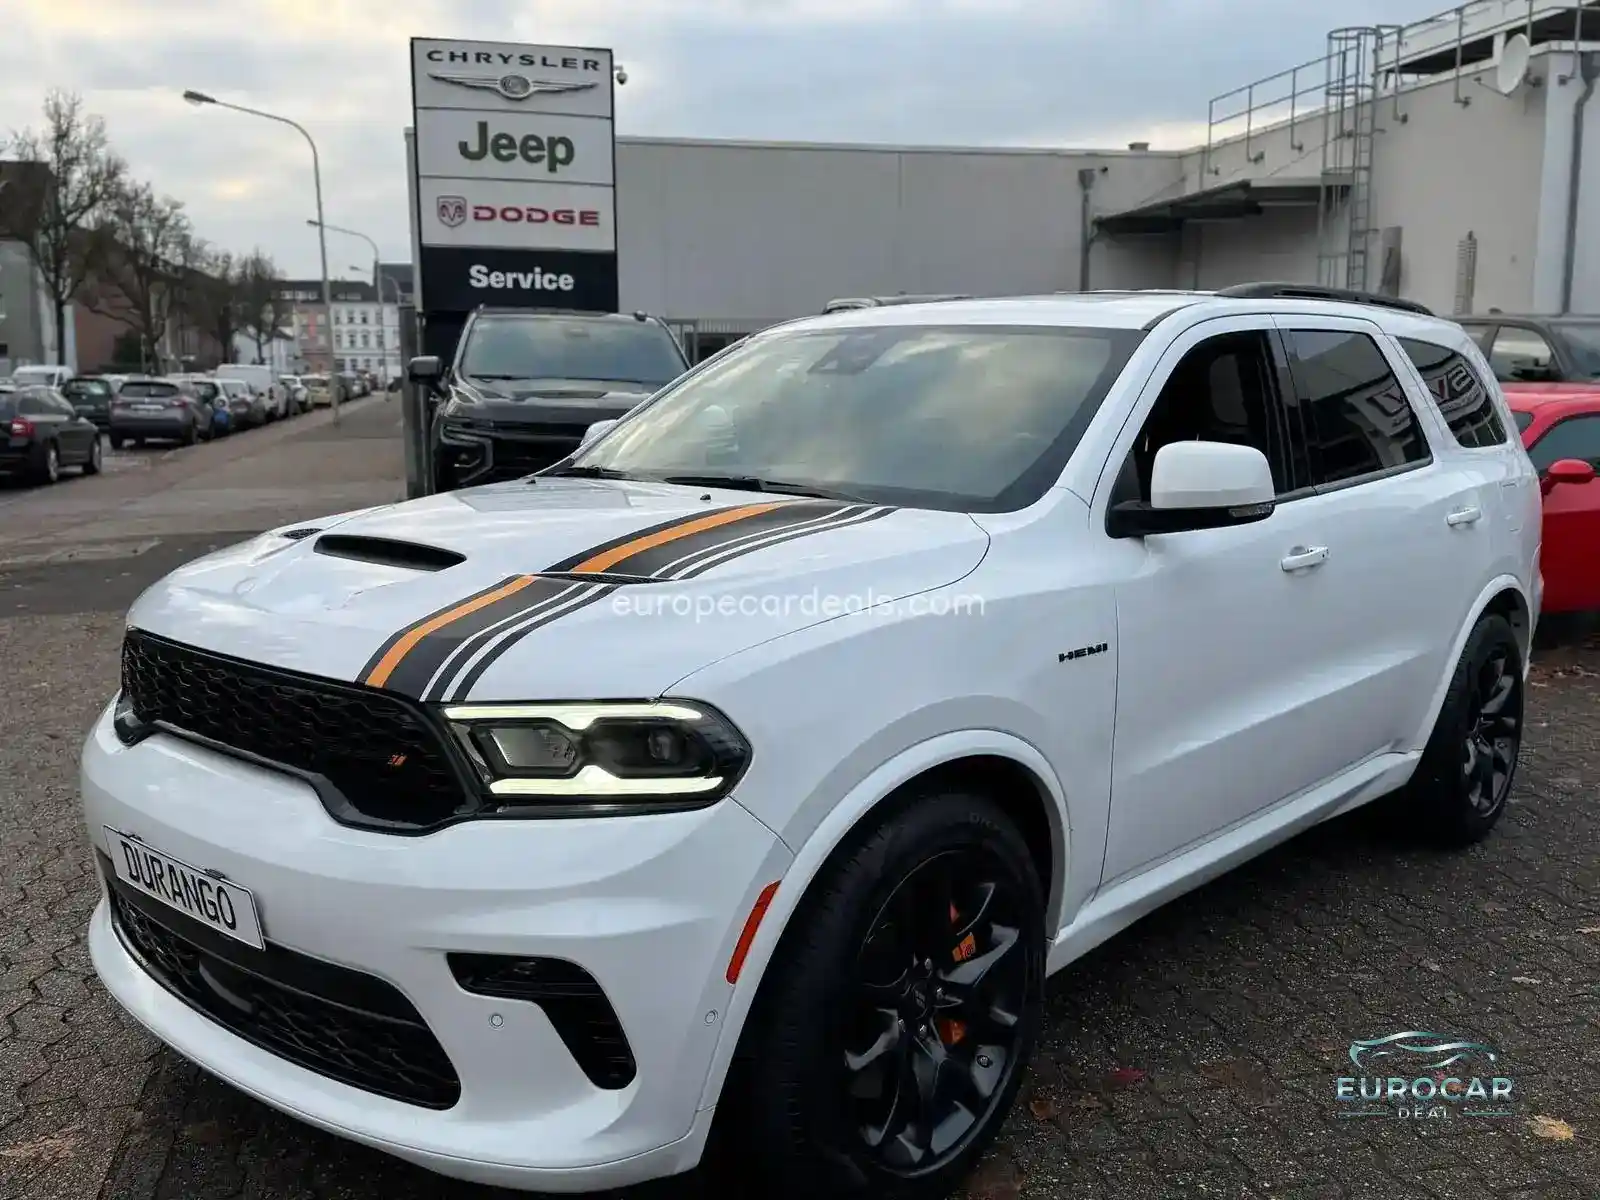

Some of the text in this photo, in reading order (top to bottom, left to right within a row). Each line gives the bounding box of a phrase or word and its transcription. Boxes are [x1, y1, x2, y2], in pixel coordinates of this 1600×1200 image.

[426, 49, 600, 71] CHRYSLER
[458, 121, 575, 173] Jeep
[473, 205, 600, 226] DODGE
[469, 264, 575, 290] Service
[1058, 643, 1108, 662] HEMI
[120, 839, 237, 931] DURANGO
